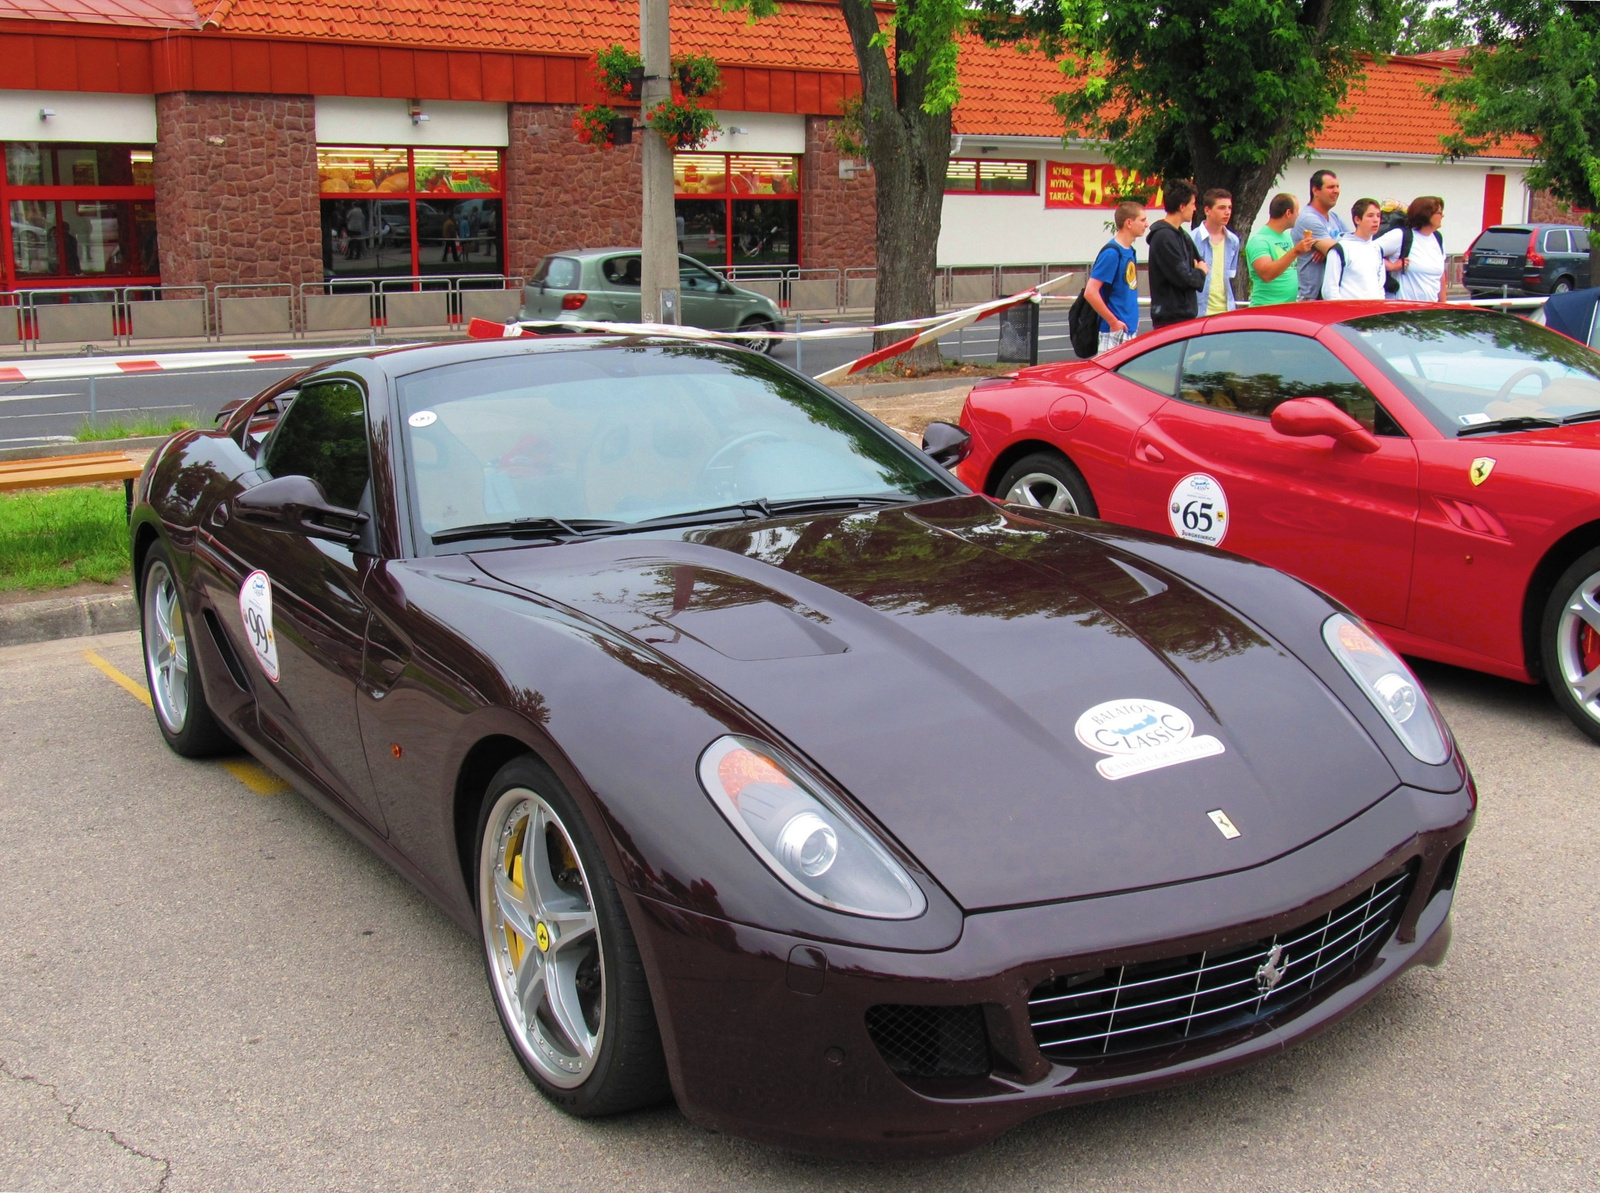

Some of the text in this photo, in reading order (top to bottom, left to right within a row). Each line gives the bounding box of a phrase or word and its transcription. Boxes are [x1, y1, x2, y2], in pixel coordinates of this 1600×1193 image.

[1050, 179, 1074, 189] NYITVA
[1049, 191, 1074, 201] TARTÁS
[1182, 500, 1213, 532] 65
[248, 607, 269, 654] 99
[1091, 703, 1156, 726] BALATON
